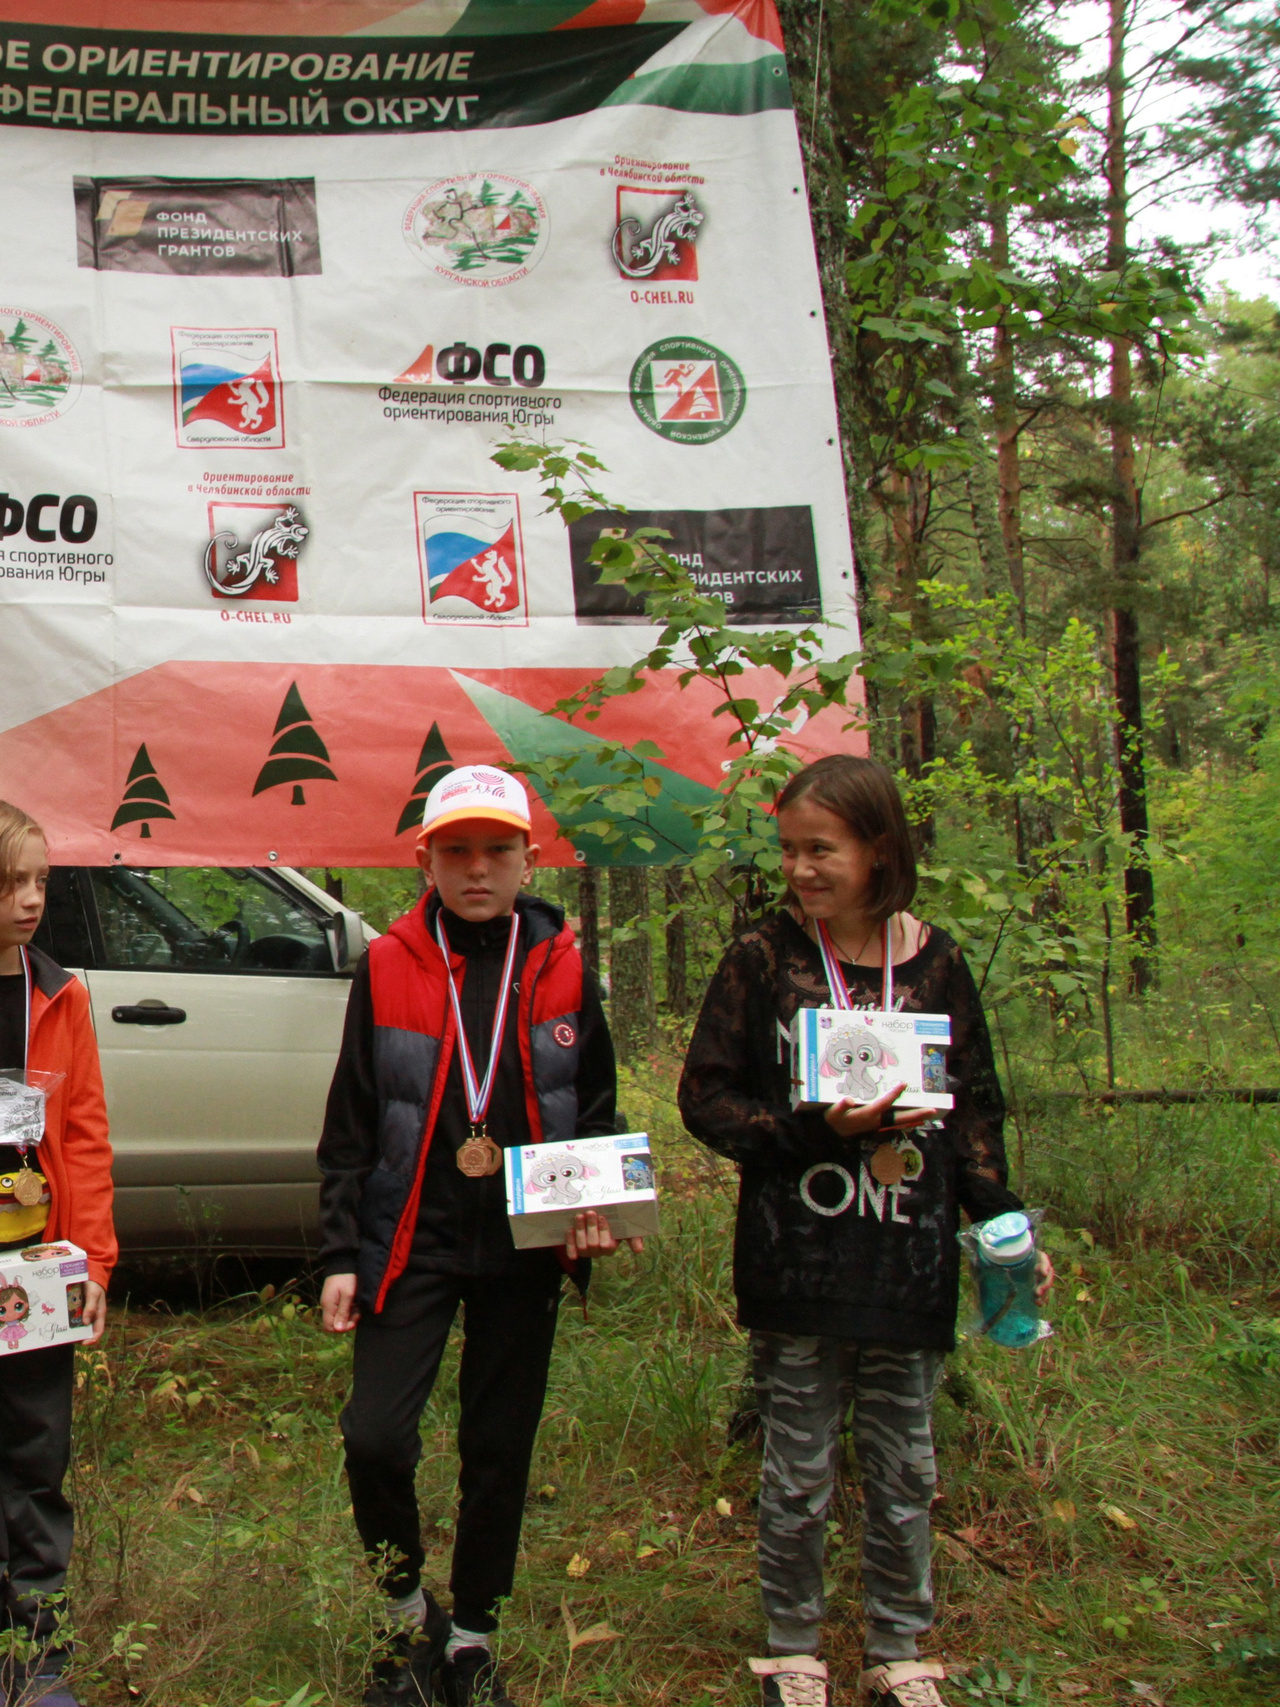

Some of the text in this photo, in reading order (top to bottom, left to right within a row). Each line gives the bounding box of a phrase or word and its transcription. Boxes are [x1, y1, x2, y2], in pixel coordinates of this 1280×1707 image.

[42, 43, 475, 82] ОРИЕНТИРОВАНИЕ
[343, 95, 479, 124] ОКРУГ
[156, 211, 207, 225] ФОНД
[157, 227, 303, 242] ПРЕЗИДЕНТСКИХ
[157, 244, 236, 257] ГРАНТОВ
[630, 290, 694, 304] O-CHEL.RU
[436, 342, 546, 388] ФСО
[378, 386, 562, 409] Федерация спортивного
[383, 406, 554, 427] ориентирования Югры
[203, 472, 294, 485] Ориентирование
[196, 483, 263, 496] Челябинской
[266, 485, 311, 496] области
[9, 550, 114, 567] спортивного
[655, 553, 704, 568] ОНД
[59, 566, 106, 586] Югры
[220, 609, 292, 624] O-CHEL.RU
[881, 1020, 913, 1030] набор
[799, 1161, 912, 1224] ONE
[32, 1265, 59, 1277] набор
